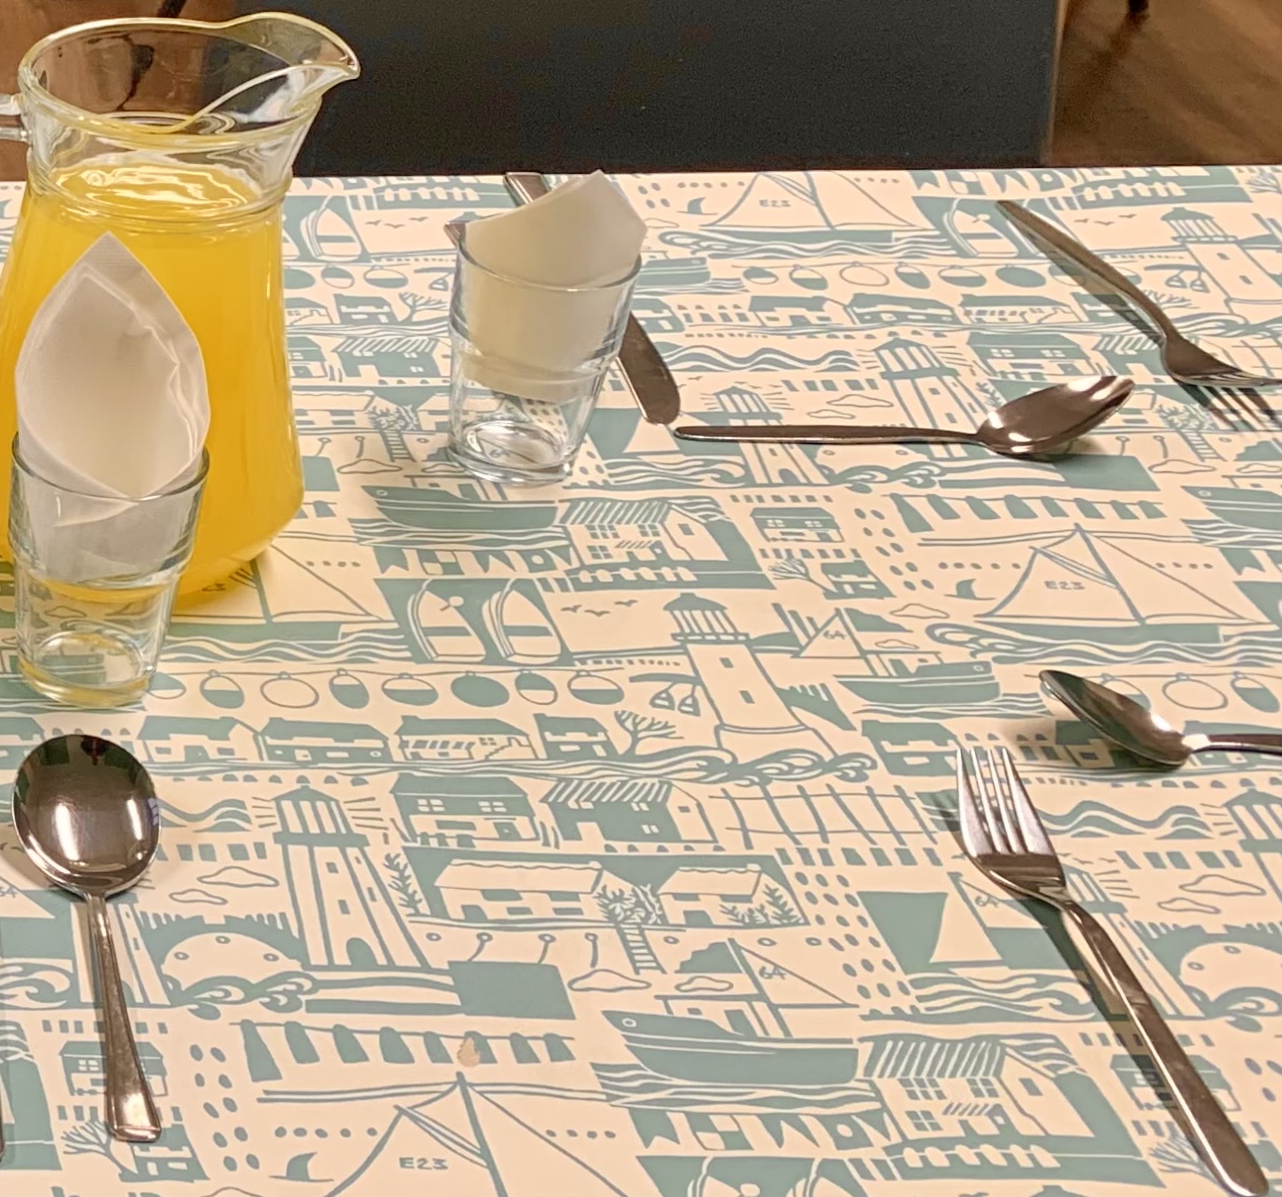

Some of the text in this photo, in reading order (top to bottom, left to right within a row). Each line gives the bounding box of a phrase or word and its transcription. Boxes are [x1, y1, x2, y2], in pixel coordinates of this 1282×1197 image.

[1044, 580, 1085, 590] E23
[823, 630, 846, 641] 64
[974, 895, 1002, 909] 64
[758, 966, 788, 981] 64
[399, 1157, 449, 1170] E23
